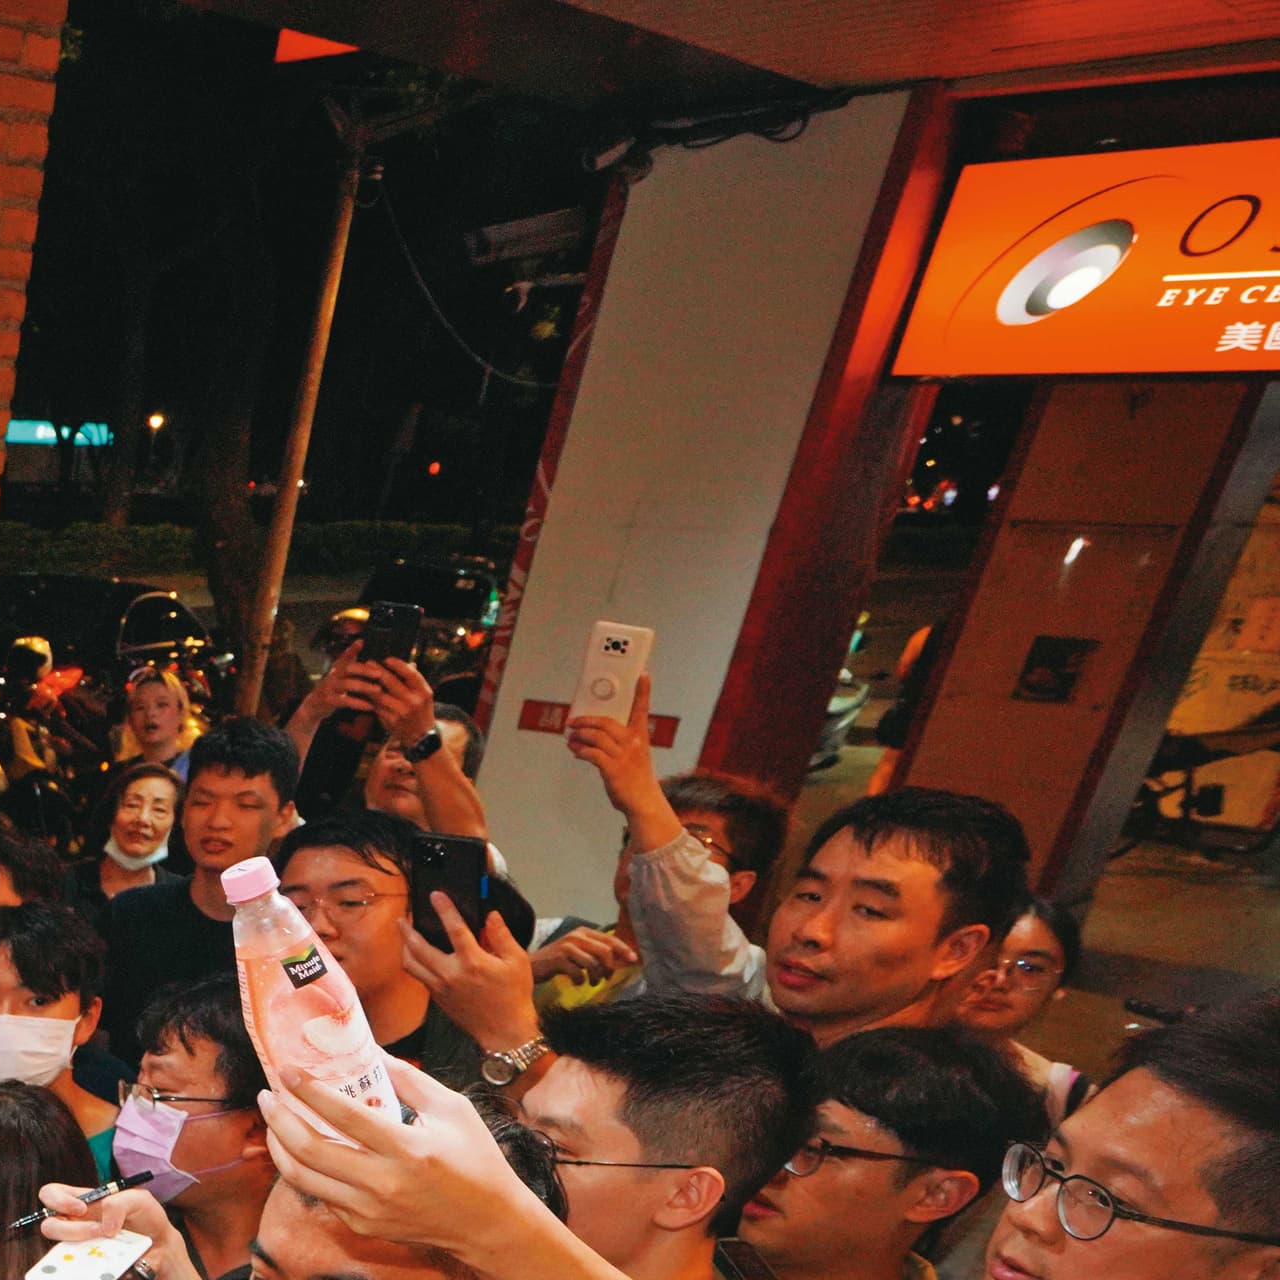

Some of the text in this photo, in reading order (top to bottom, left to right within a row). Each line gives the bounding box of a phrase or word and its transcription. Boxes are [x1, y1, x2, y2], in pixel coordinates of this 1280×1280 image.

[1156, 286, 1230, 307] EYE
[289, 954, 321, 976] Minute
[298, 962, 322, 981] Maid
